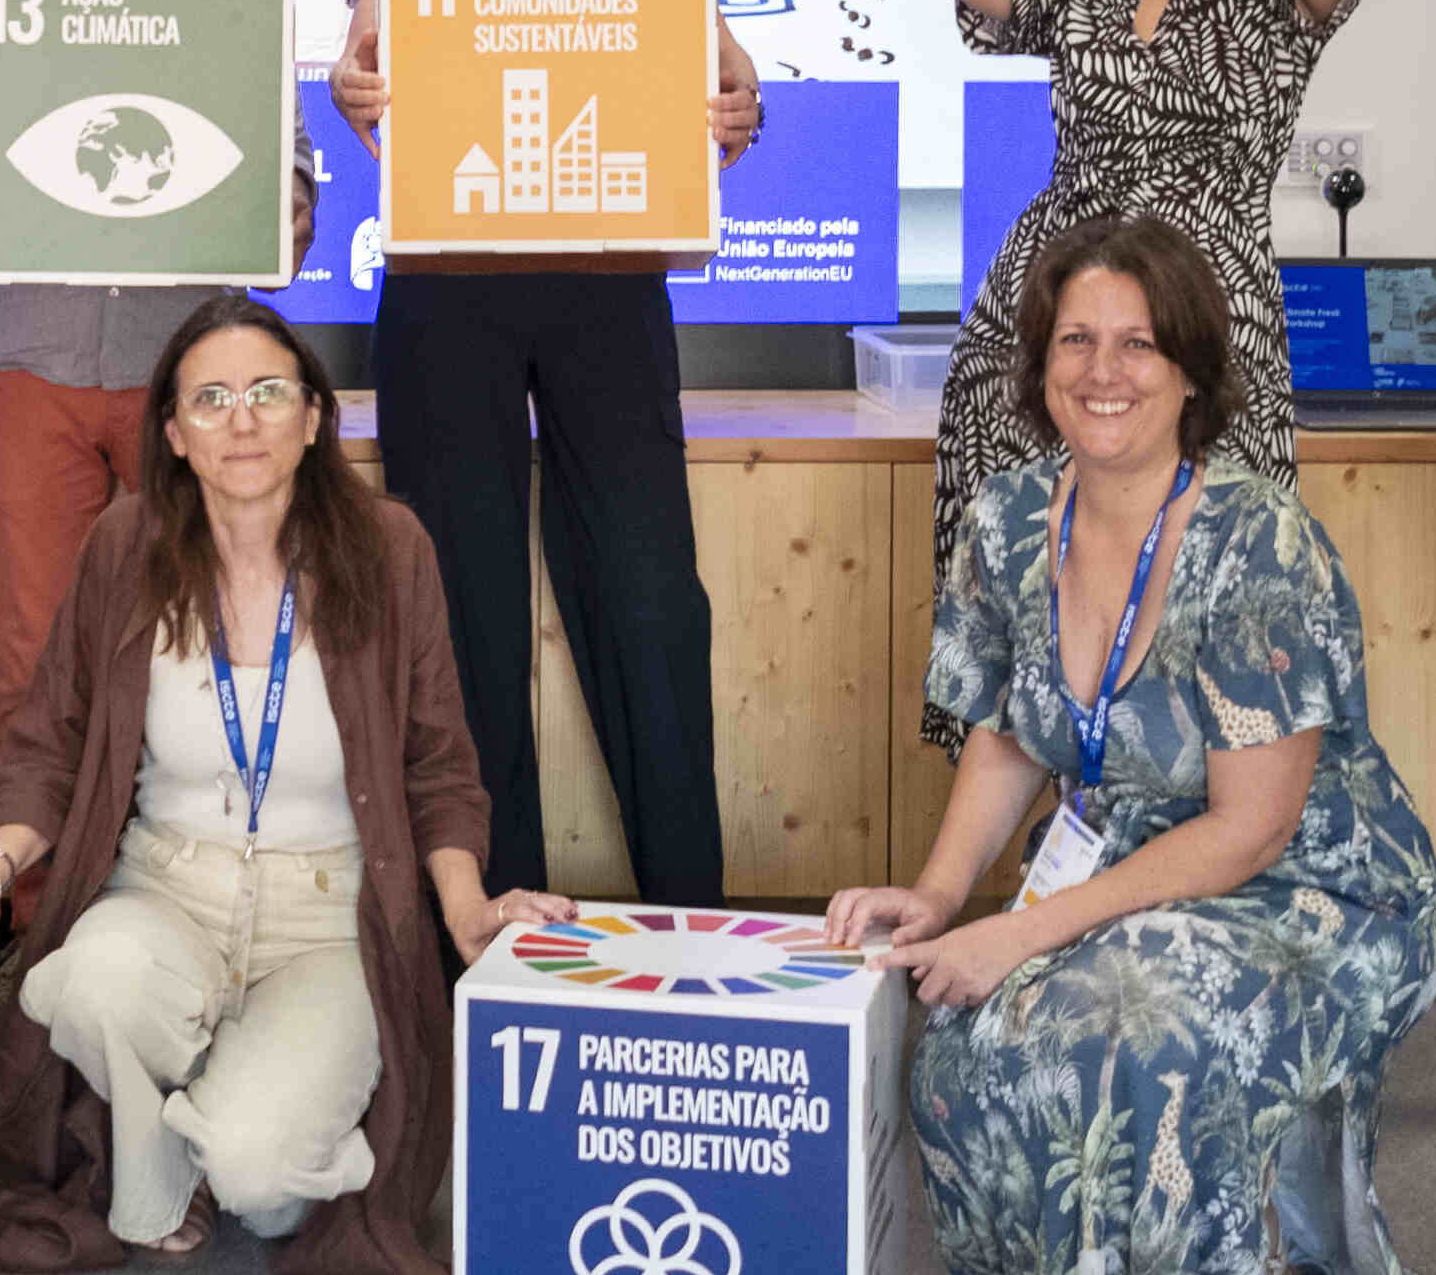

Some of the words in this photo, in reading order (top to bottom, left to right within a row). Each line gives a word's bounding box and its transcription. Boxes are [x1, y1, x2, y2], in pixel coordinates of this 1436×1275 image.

[61, 6, 180, 45] CLIMÁTICA
[473, 16, 638, 53] SUSTENTÁVEIS
[714, 265, 854, 283] NextGenerationEU
[489, 1025, 562, 1112] 17
[579, 1033, 731, 1082] PARCERIAS
[735, 1044, 811, 1086] PARA
[577, 1080, 599, 1117] A
[603, 1081, 831, 1140] IMPLEMENTAÇÃO
[578, 1125, 636, 1164] DOS
[640, 1130, 791, 1177] OBJETIVOS
